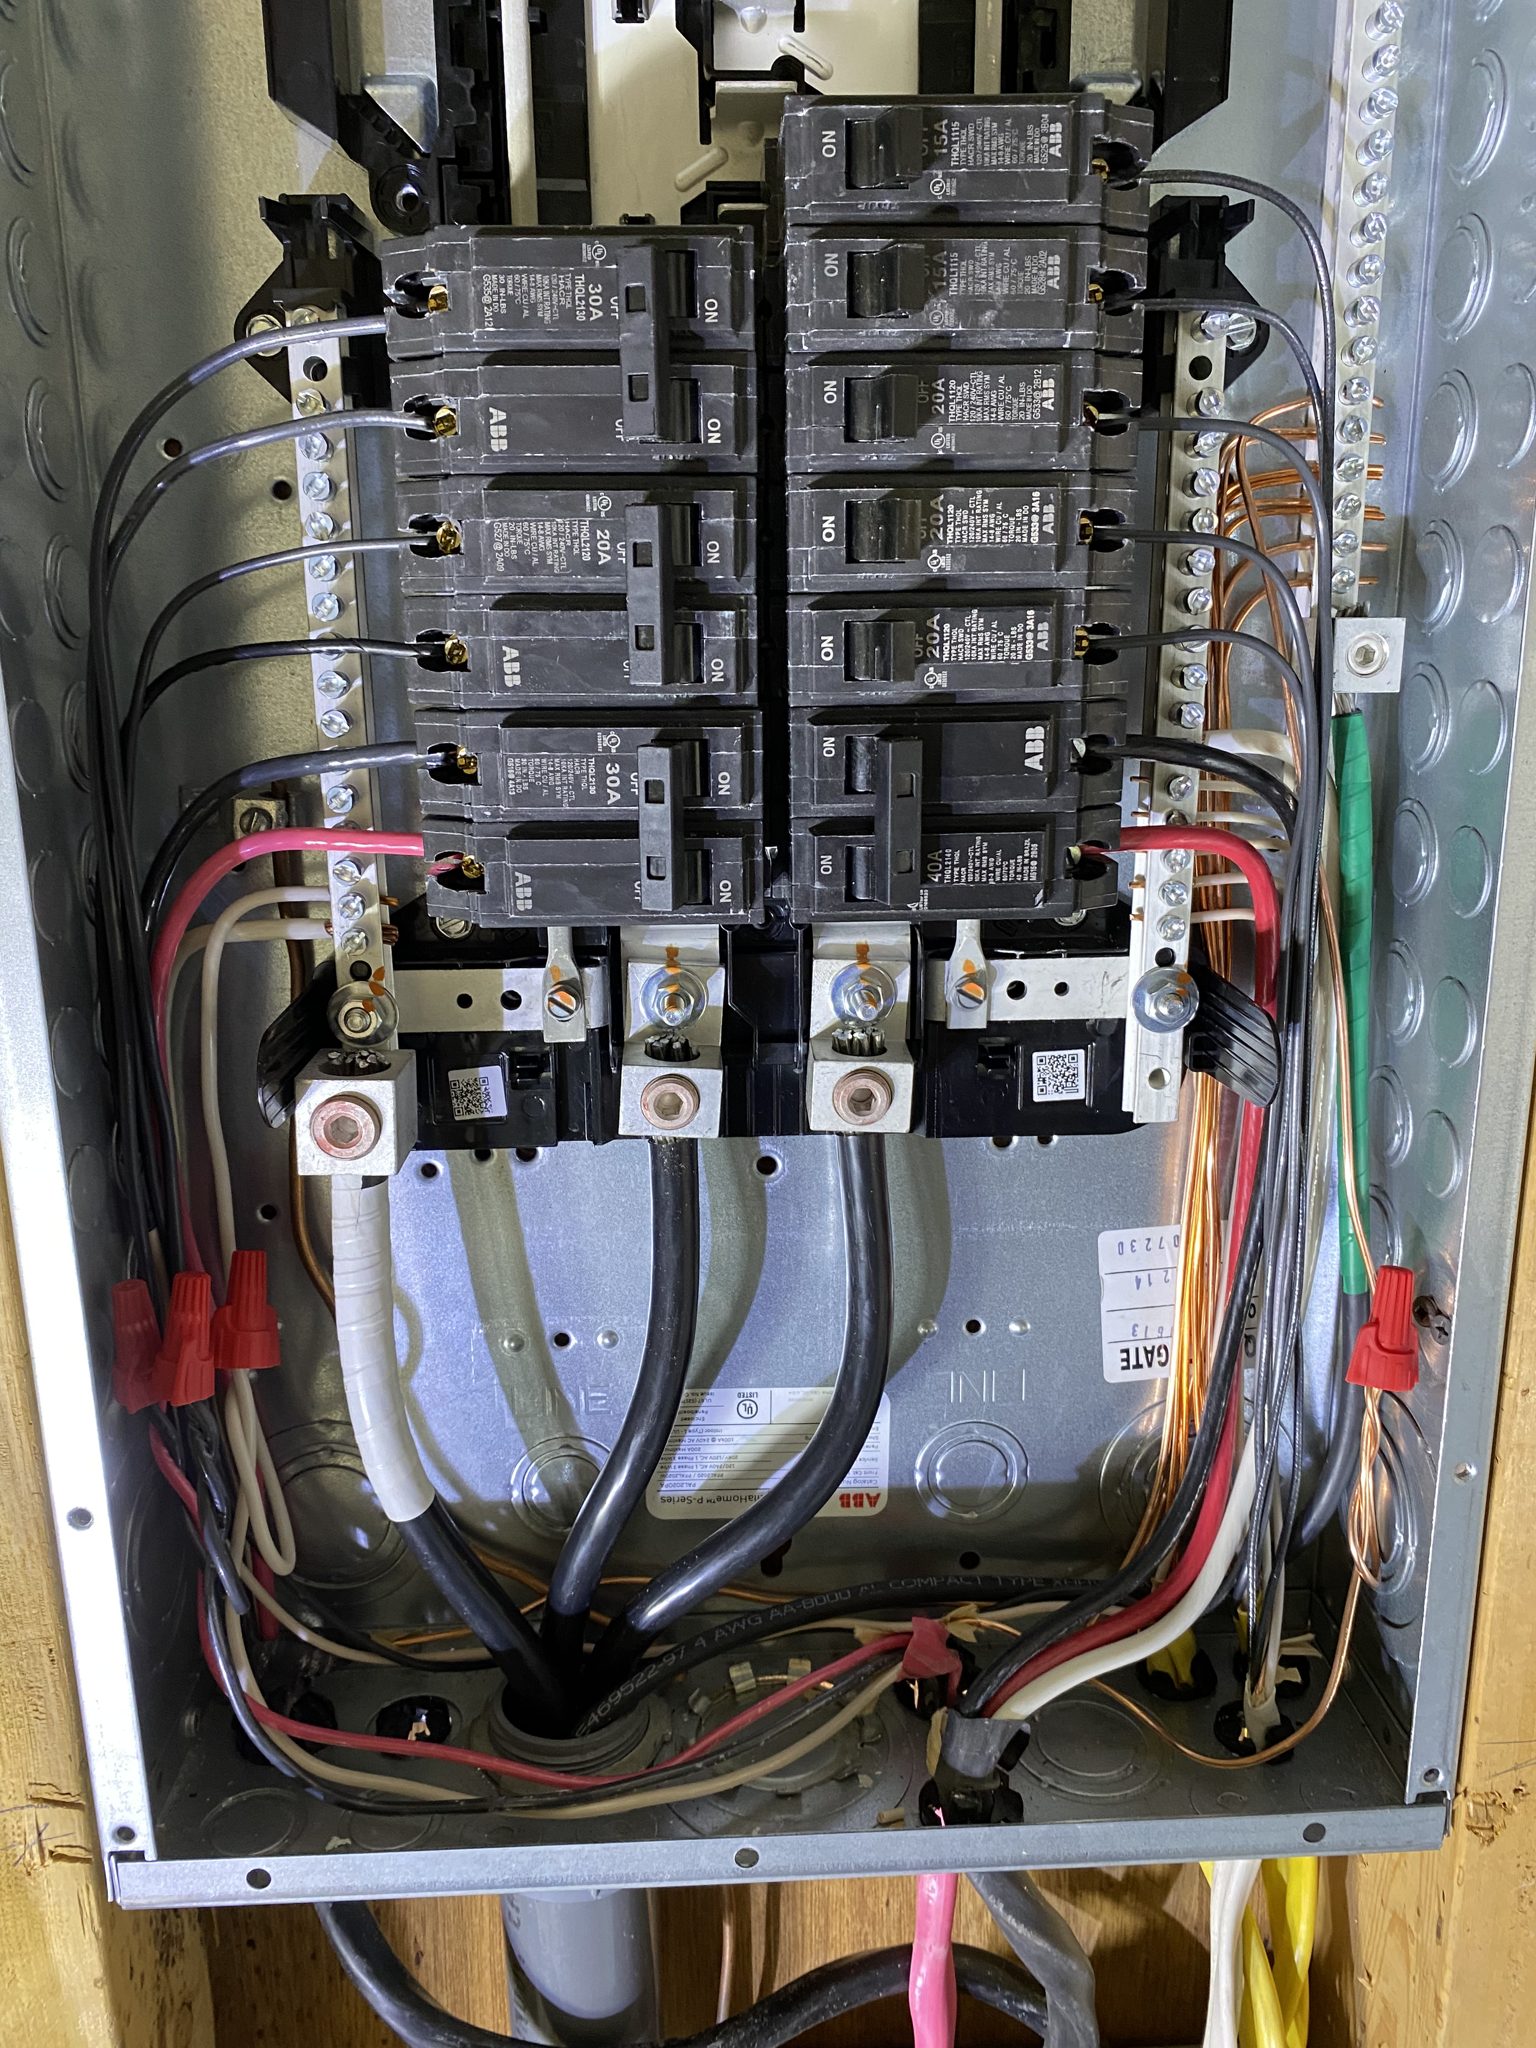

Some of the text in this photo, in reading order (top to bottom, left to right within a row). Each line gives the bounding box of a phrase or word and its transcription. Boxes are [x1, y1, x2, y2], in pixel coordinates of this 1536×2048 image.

[823, 130, 836, 158] ON
[934, 119, 948, 154] 15A
[951, 122, 959, 166] THQL1115
[1050, 122, 1062, 157] ABB
[825, 253, 838, 277] ON
[934, 252, 946, 288] 15A
[949, 252, 958, 296] THQL1115
[1047, 255, 1060, 289] ABB
[575, 274, 585, 321] THQL2130
[589, 284, 603, 320] 30A
[705, 299, 718, 323] ON
[484, 307, 493, 327] 2A12
[824, 380, 837, 404] ON
[918, 380, 929, 403] OFF
[999, 374, 1004, 384] AL
[932, 378, 945, 414] 20A
[998, 390, 1004, 400] CU
[1042, 378, 1054, 410] ABB
[1019, 411, 1025, 420] 20
[489, 407, 507, 452] ABB
[708, 419, 721, 444] ON
[1023, 505, 1029, 514] DO
[1032, 492, 1040, 512] 3A16
[823, 515, 835, 542] ON
[930, 494, 944, 540] 20A
[996, 516, 1002, 524] CU
[1043, 504, 1054, 534] ABB
[580, 521, 590, 561] THQL2120
[597, 529, 611, 565] 20A
[707, 542, 719, 564] ON
[495, 553, 504, 571] 2A09
[927, 614, 940, 658] 20A
[992, 620, 997, 628] AL
[1018, 624, 1024, 632] DO
[1037, 622, 1049, 650] ABB
[821, 635, 834, 661] ON
[991, 634, 997, 642] CU
[502, 646, 521, 687] ABB
[711, 658, 724, 682] ON
[823, 737, 835, 757] ON
[1024, 726, 1044, 770] ABB
[588, 758, 596, 794] THQL2130
[606, 763, 620, 805] 30A
[718, 773, 730, 795] ON
[821, 855, 832, 875] ON
[927, 850, 942, 882] 40A
[944, 848, 952, 883] THQL2140
[514, 872, 533, 911] ABB
[720, 880, 732, 903] ON
[1120, 1344, 1169, 1371] GATE
[853, 1478, 878, 1486] Catalog
[660, 1494, 703, 1505] P-Series
[839, 1493, 880, 1508] ABB
[713, 1614, 763, 1642] AWG
